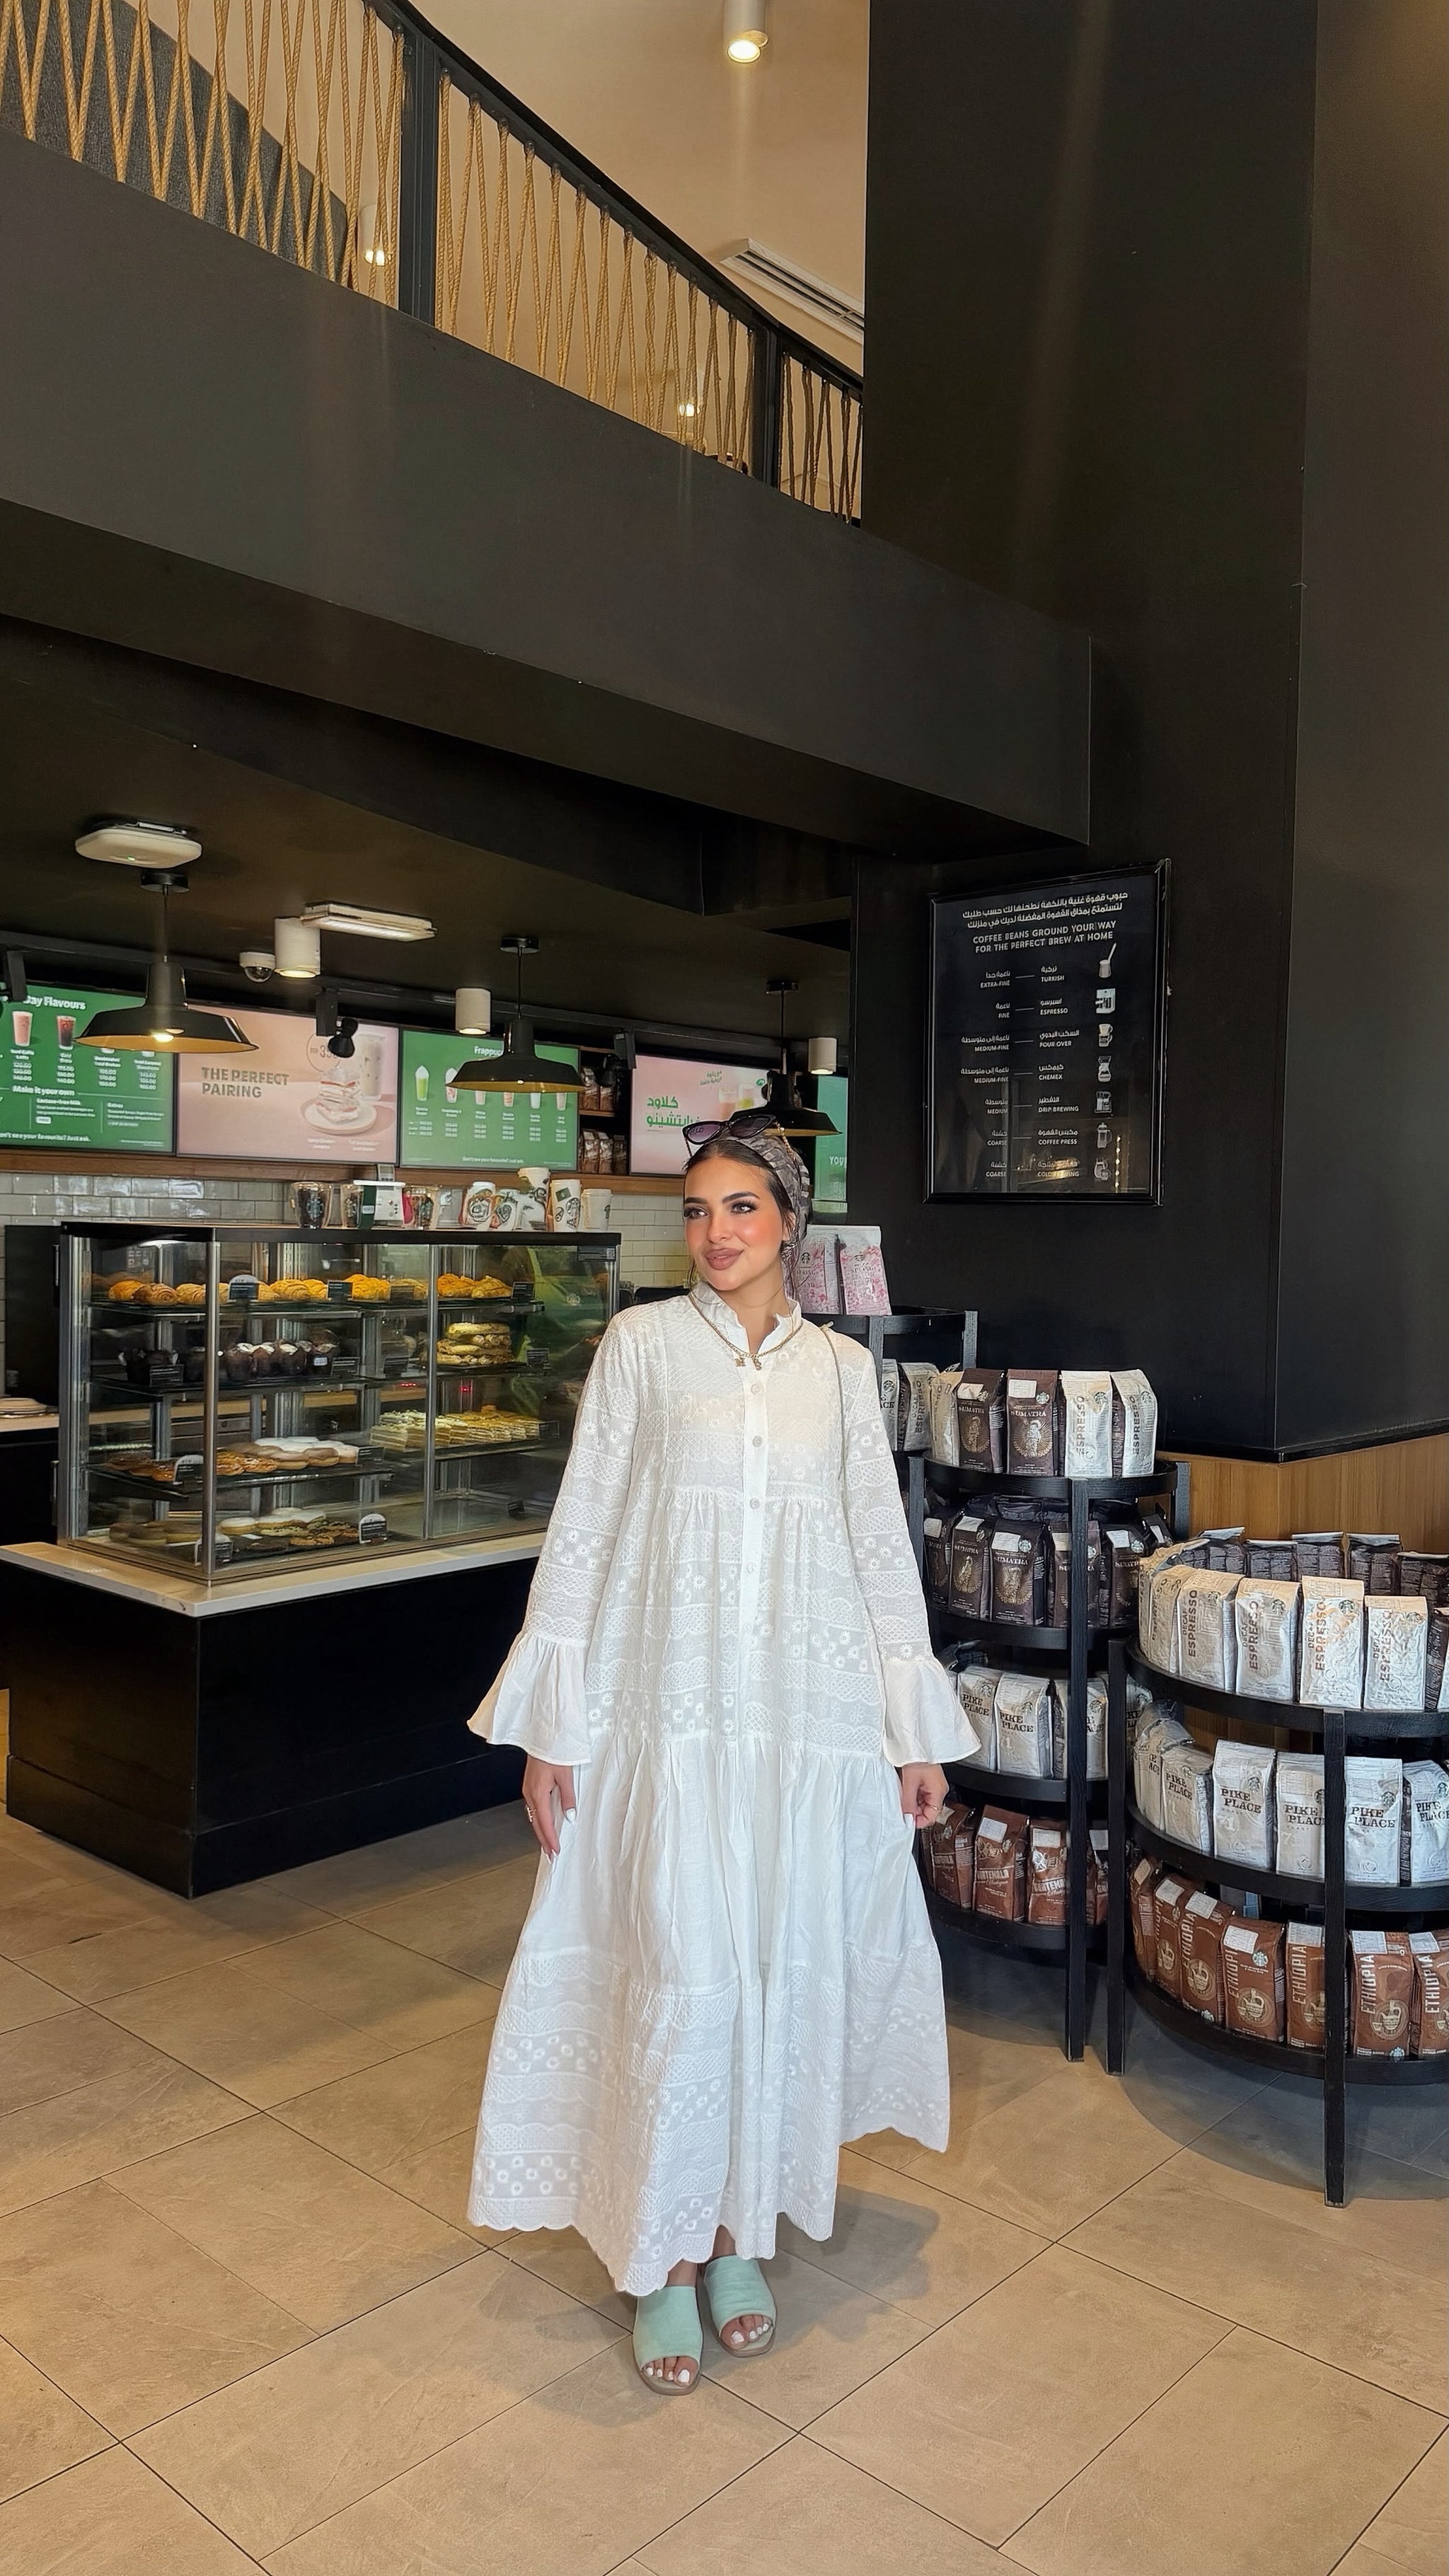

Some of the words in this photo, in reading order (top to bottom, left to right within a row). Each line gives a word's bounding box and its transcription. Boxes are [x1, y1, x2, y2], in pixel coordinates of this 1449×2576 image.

[1068, 896, 1085, 906] غنية
[1086, 894, 1105, 903] قهوة
[1107, 892, 1128, 902] حبوب
[1013, 902, 1039, 912] نطحنها
[1041, 899, 1067, 908] بالنكهة
[1091, 903, 1123, 914] لتستمتع
[962, 910, 981, 919] طلبك
[982, 908, 1002, 917] حسب
[1017, 912, 1046, 922] المفضلة
[1047, 908, 1069, 919] القهوة
[1070, 907, 1090, 916] بمذاق
[967, 920, 987, 928] منزلك
[988, 918, 999, 929] في
[1000, 916, 1016, 925] لديك
[973, 933, 1003, 944] COFFEE
[1005, 931, 1029, 941] BEANS
[1032, 926, 1068, 937] GROUND
[1071, 923, 1095, 933] YOUR
[1097, 920, 1116, 930] WAY
[976, 945, 991, 954] FOR
[993, 943, 1008, 952] THE
[1010, 940, 1045, 950] PERFECT
[1049, 936, 1071, 945] BREW
[1074, 934, 1085, 943] AT
[1087, 931, 1113, 942] HOME
[980, 980, 1010, 988] EXTRA-FINE
[43, 996, 86, 1010] Flavours
[474, 1046, 504, 1057] Frappuc
[201, 1067, 229, 1081] THE
[231, 1069, 289, 1086] PERFECT
[13, 1085, 34, 1094] Make
[202, 1082, 262, 1098] PAIRING
[647, 1095, 679, 1109] كلاود
[829, 1155, 846, 1167] YOU
[1076, 1396, 1086, 1455] ESPRESSO
[1129, 1396, 1140, 1455] ESPRESSO
[994, 1556, 1028, 1566] SUMATRA
[1188, 1590, 1198, 1657] ESPRESSO
[1248, 1600, 1259, 1670] ESPRESSO
[1315, 1597, 1327, 1671] ESPRESSO
[962, 1694, 983, 1706] PIKE
[964, 1702, 989, 1716] PLACE
[1000, 1711, 1023, 1723] PIKE
[1002, 1721, 1034, 1732] PLACE
[1087, 1723, 1104, 1733] ACE
[1166, 1772, 1187, 1788] PIKE
[1168, 1781, 1193, 1801] PLACE
[1220, 1788, 1251, 1801] PIKE
[1224, 1798, 1262, 1813] PLACE
[1284, 1804, 1318, 1816] PIKE
[1416, 1801, 1441, 1812] PIKE
[1351, 1807, 1384, 1818] PIKE
[1288, 1815, 1324, 1826] PLAC
[1354, 1817, 1395, 1828] PLACE
[1181, 1912, 1197, 1969] ETHIOPIA
[1225, 1948, 1239, 1999] ETHIOPI
[1291, 1946, 1307, 2005] ETHIOPIA
[1360, 1954, 1377, 2014] ETHIOPIA
[1417, 1955, 1441, 2014] ETHIOPIA
